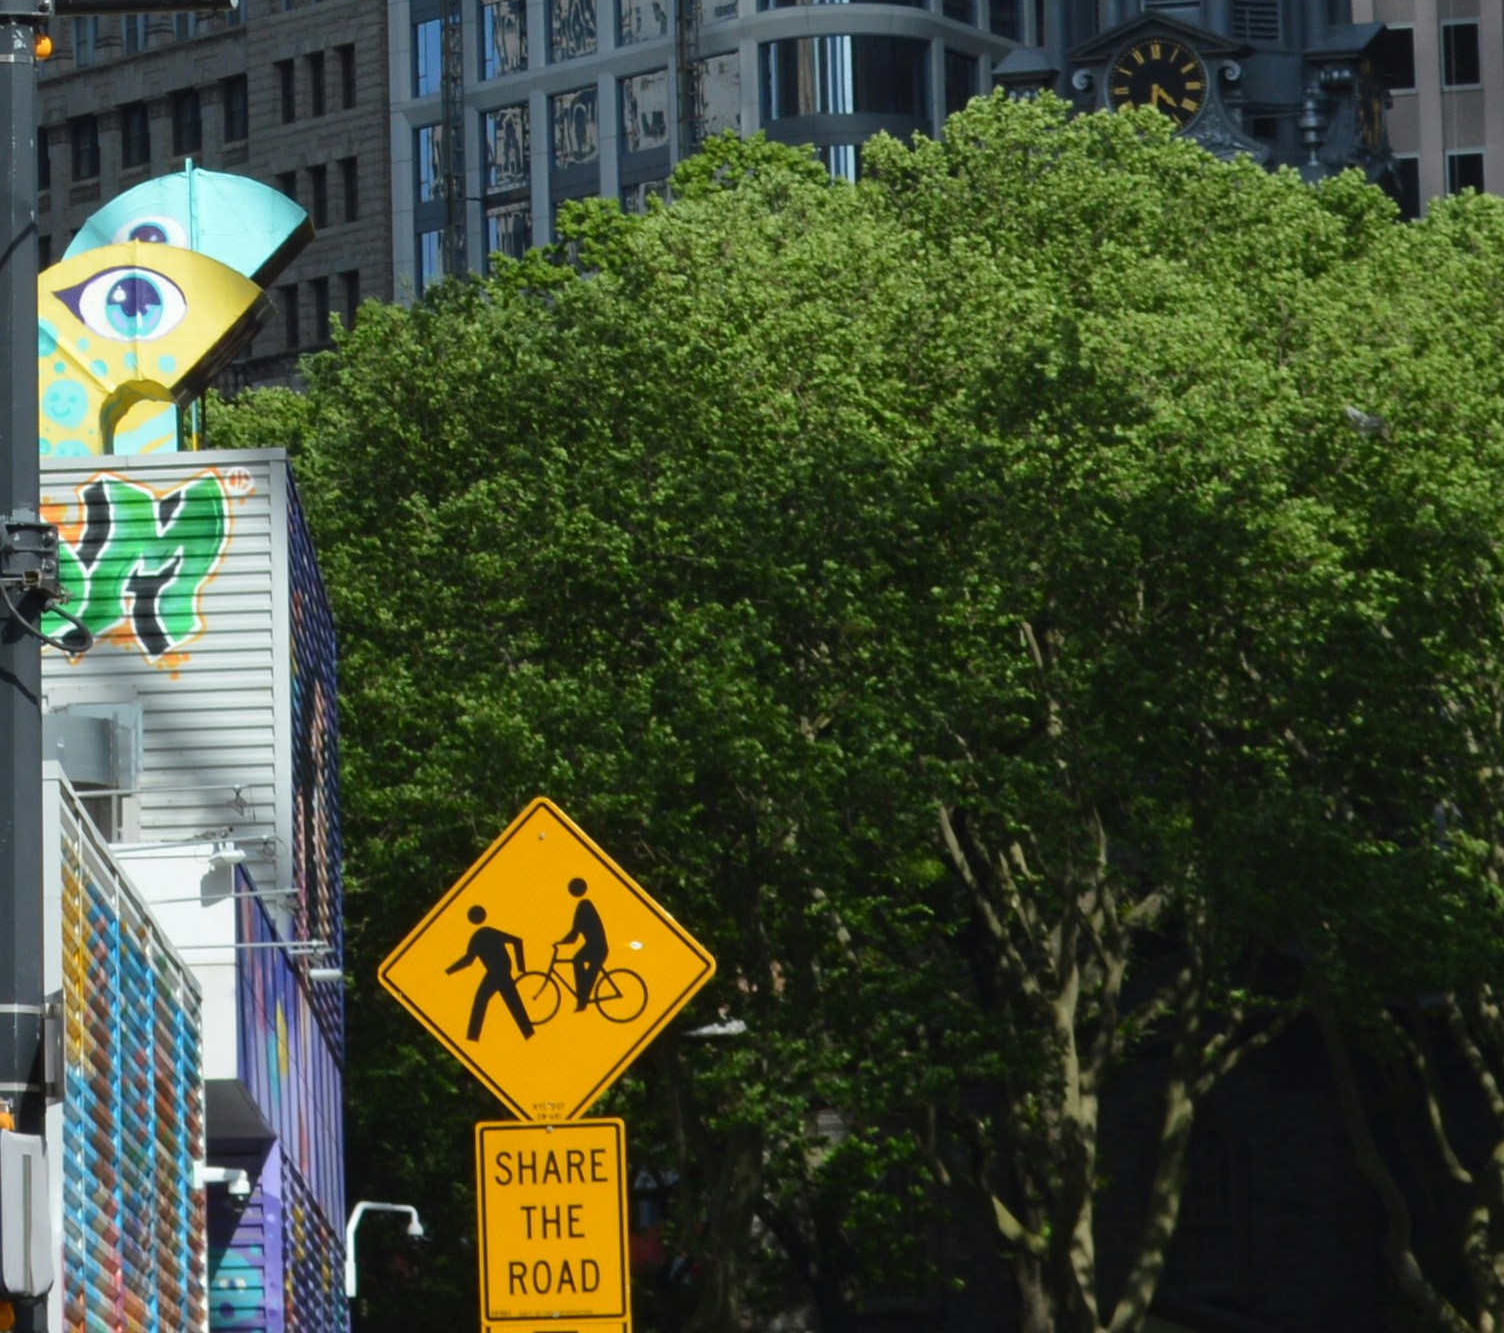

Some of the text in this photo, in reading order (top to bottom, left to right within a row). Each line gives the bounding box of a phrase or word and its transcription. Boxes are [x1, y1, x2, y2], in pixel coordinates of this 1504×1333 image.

[494, 1148, 609, 1186] SHARE
[520, 1204, 586, 1240] THE
[508, 1258, 601, 1296] ROAD
